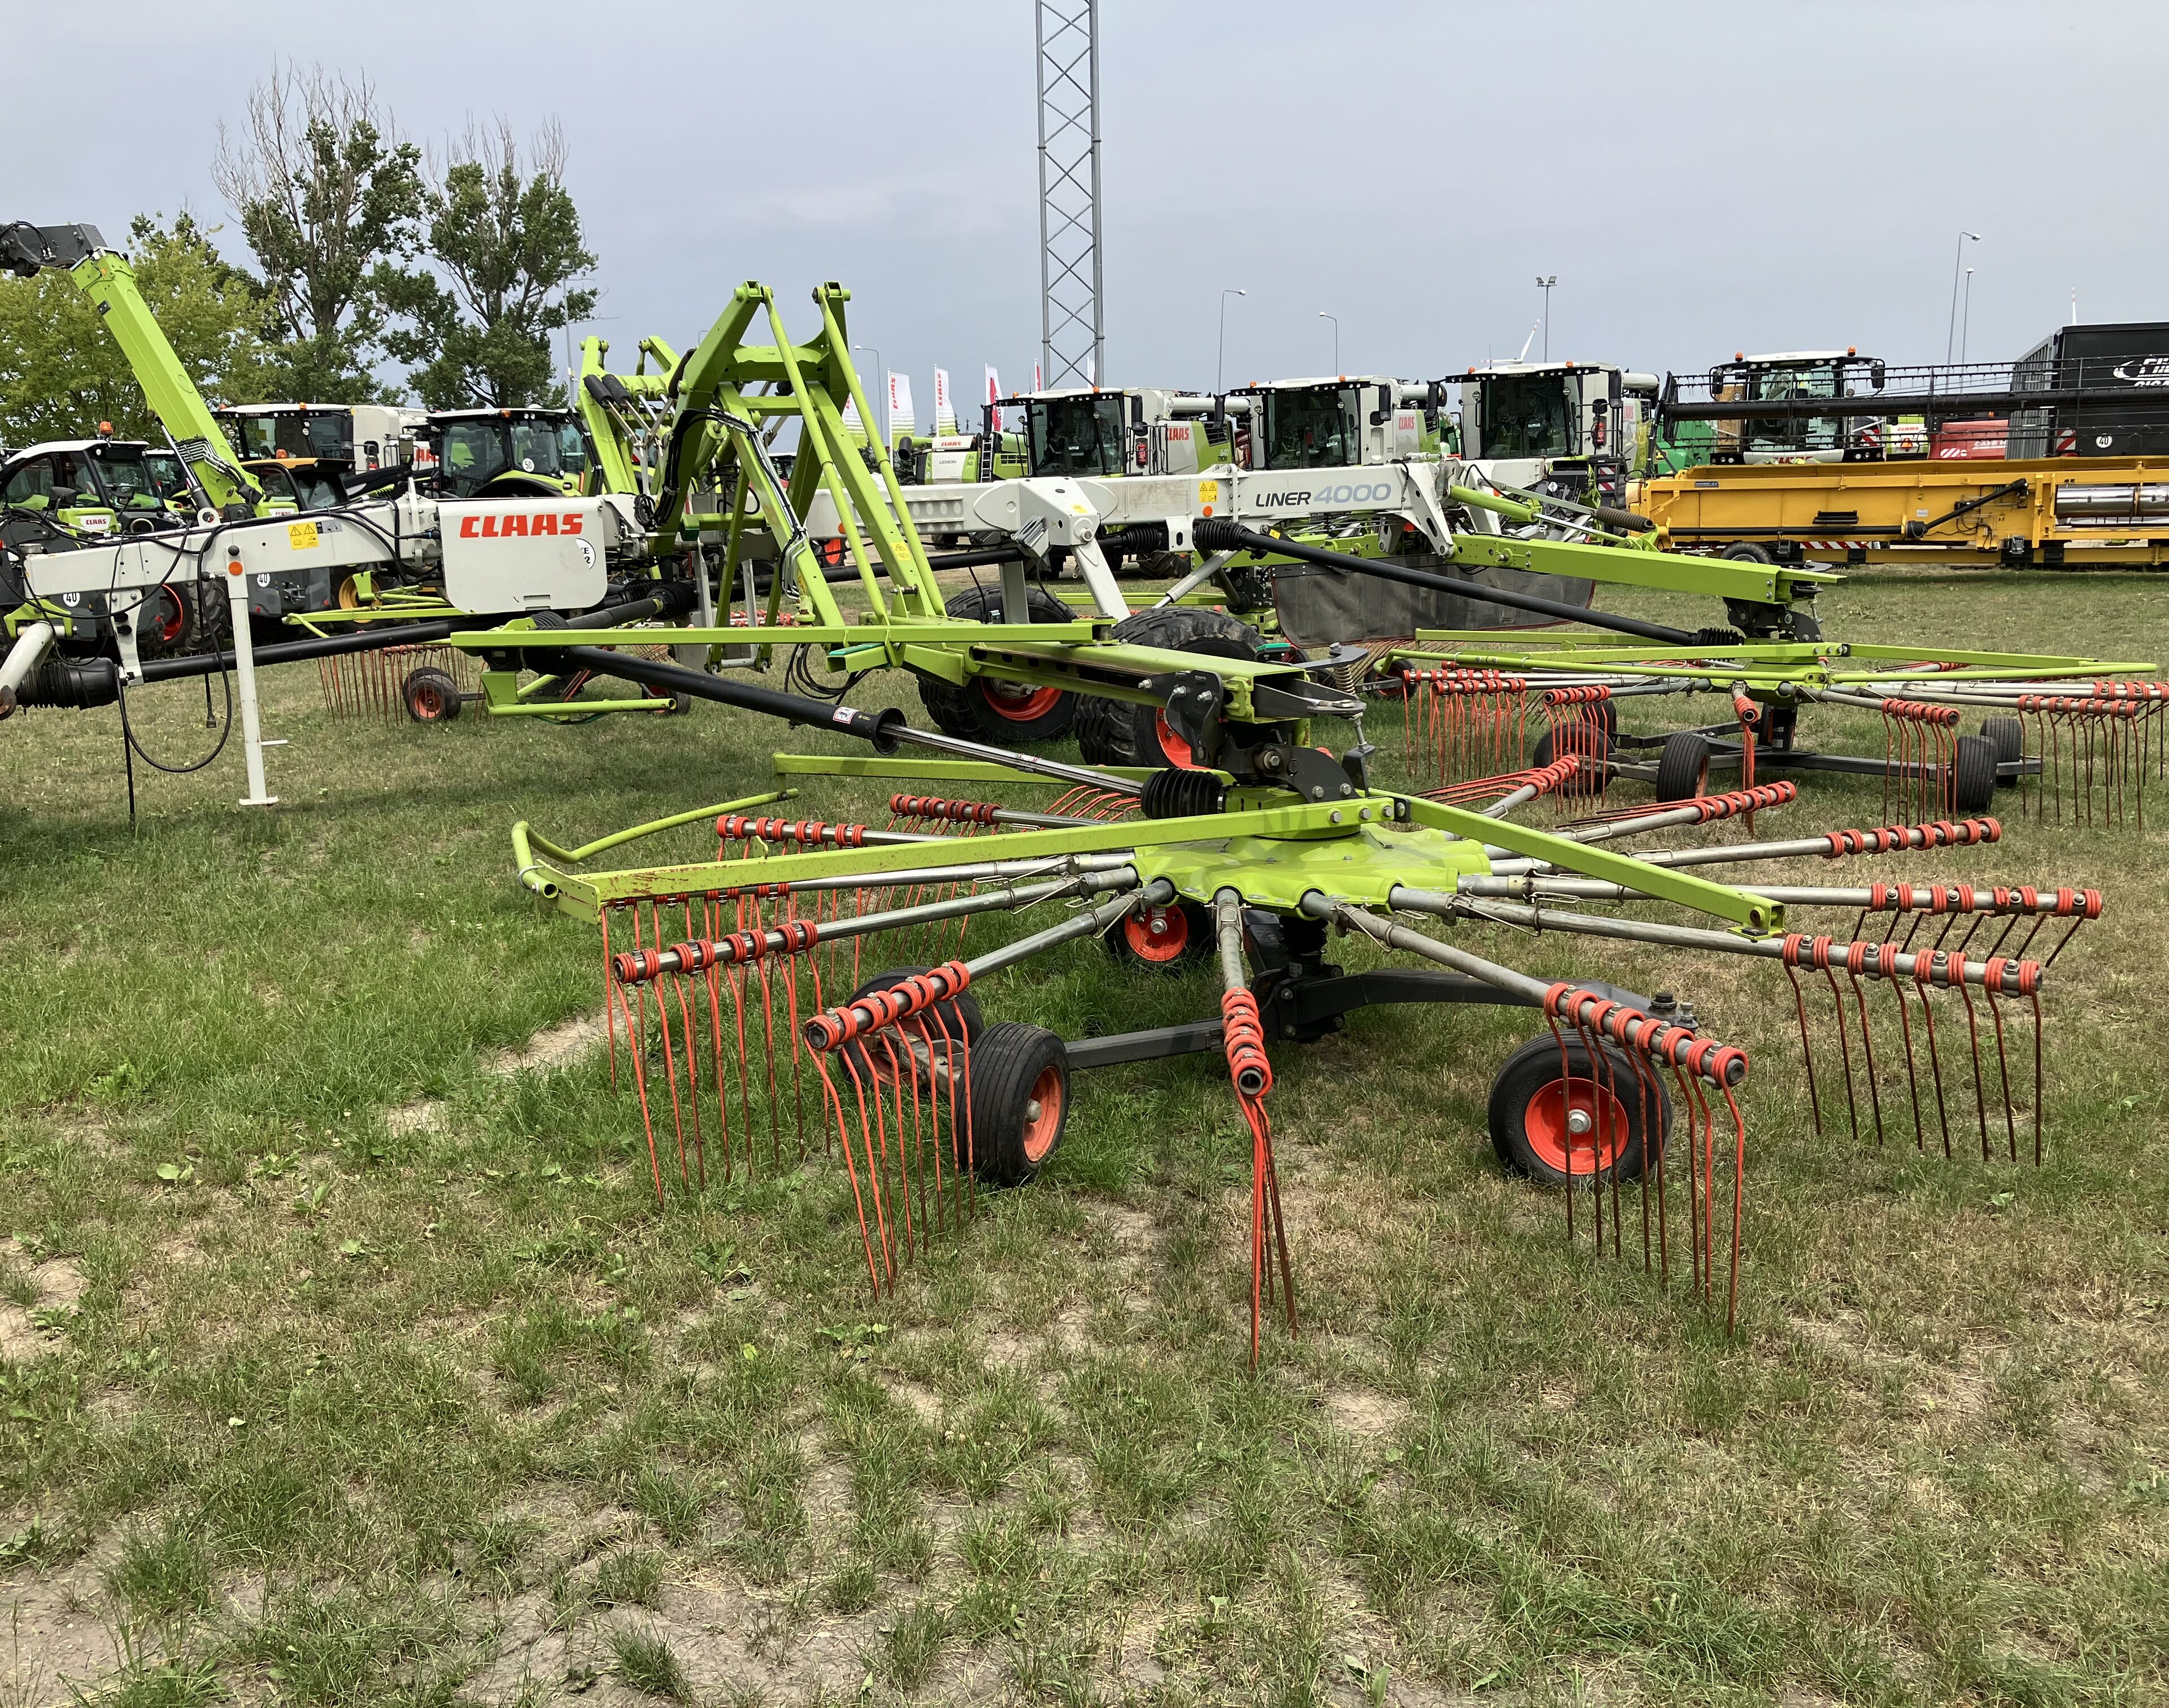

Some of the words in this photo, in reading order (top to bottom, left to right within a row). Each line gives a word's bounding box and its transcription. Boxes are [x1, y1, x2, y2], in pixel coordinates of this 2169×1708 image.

[1399, 417, 1414, 430] CLAAS
[2099, 435, 2109, 446] 40
[1256, 491, 1311, 507] LINER
[1314, 483, 1391, 504] 4000
[460, 513, 583, 538] CLAAS
[259, 573, 268, 583] 40
[66, 593, 77, 603] 40
